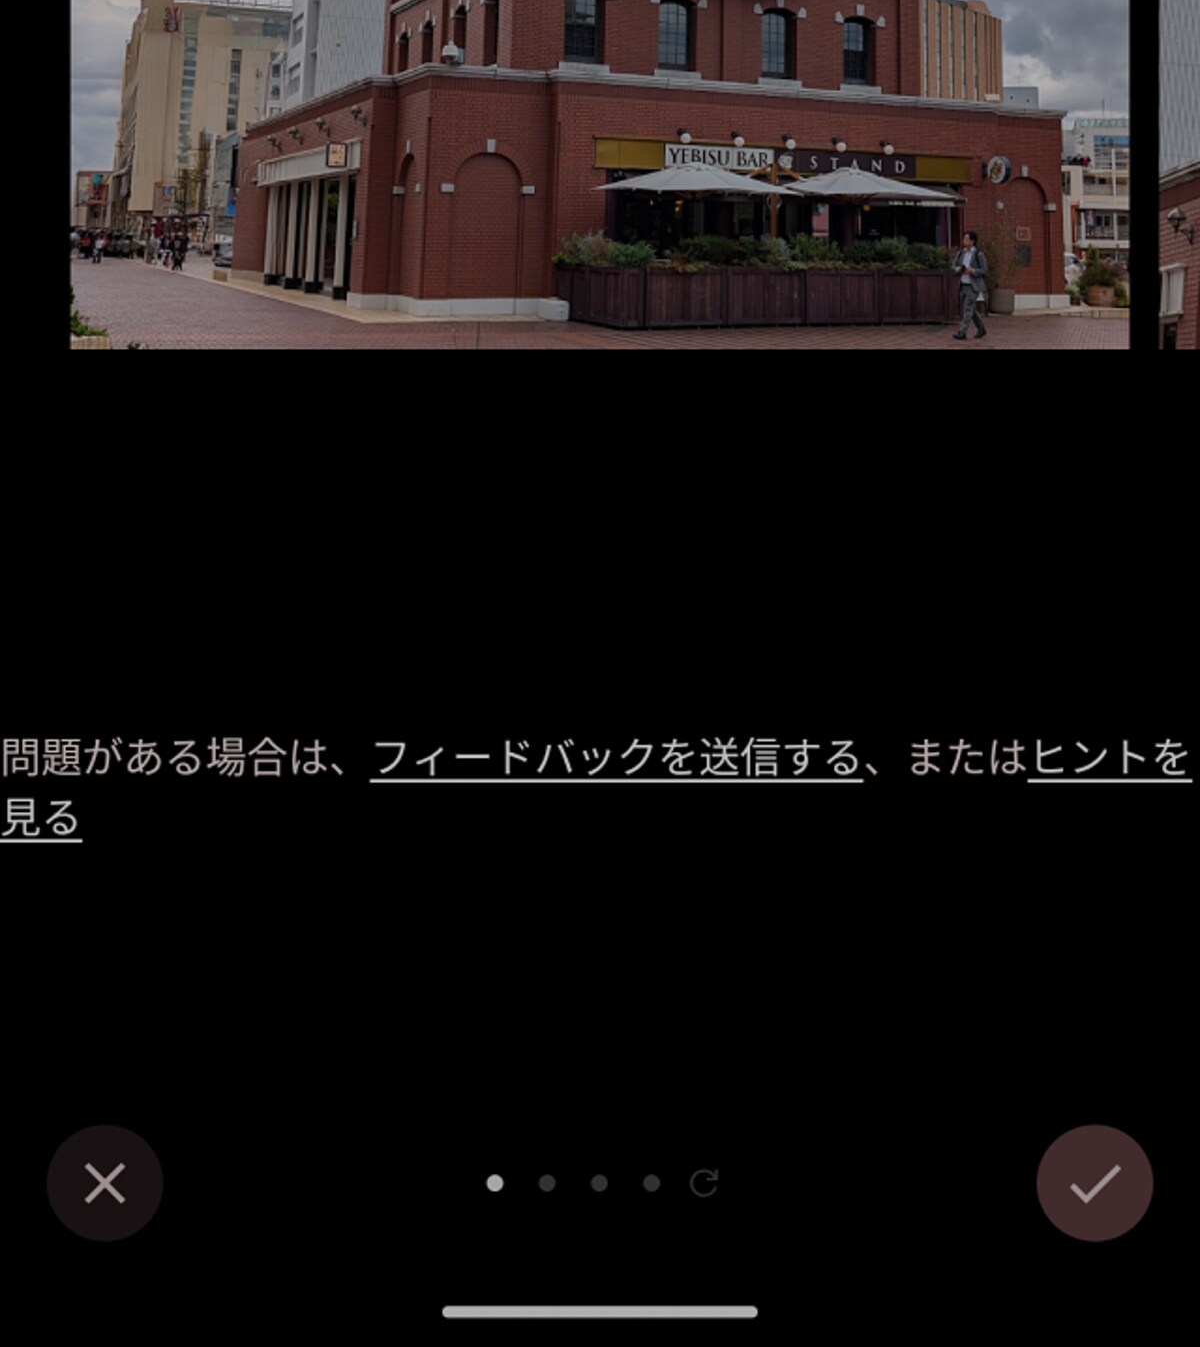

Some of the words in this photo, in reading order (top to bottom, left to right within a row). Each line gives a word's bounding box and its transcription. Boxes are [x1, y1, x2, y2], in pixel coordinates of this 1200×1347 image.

[669, 147, 730, 166] YEBISU
[737, 149, 768, 167] BAR
[809, 155, 906, 174] STAND
[1, 797, 79, 837] 見る
